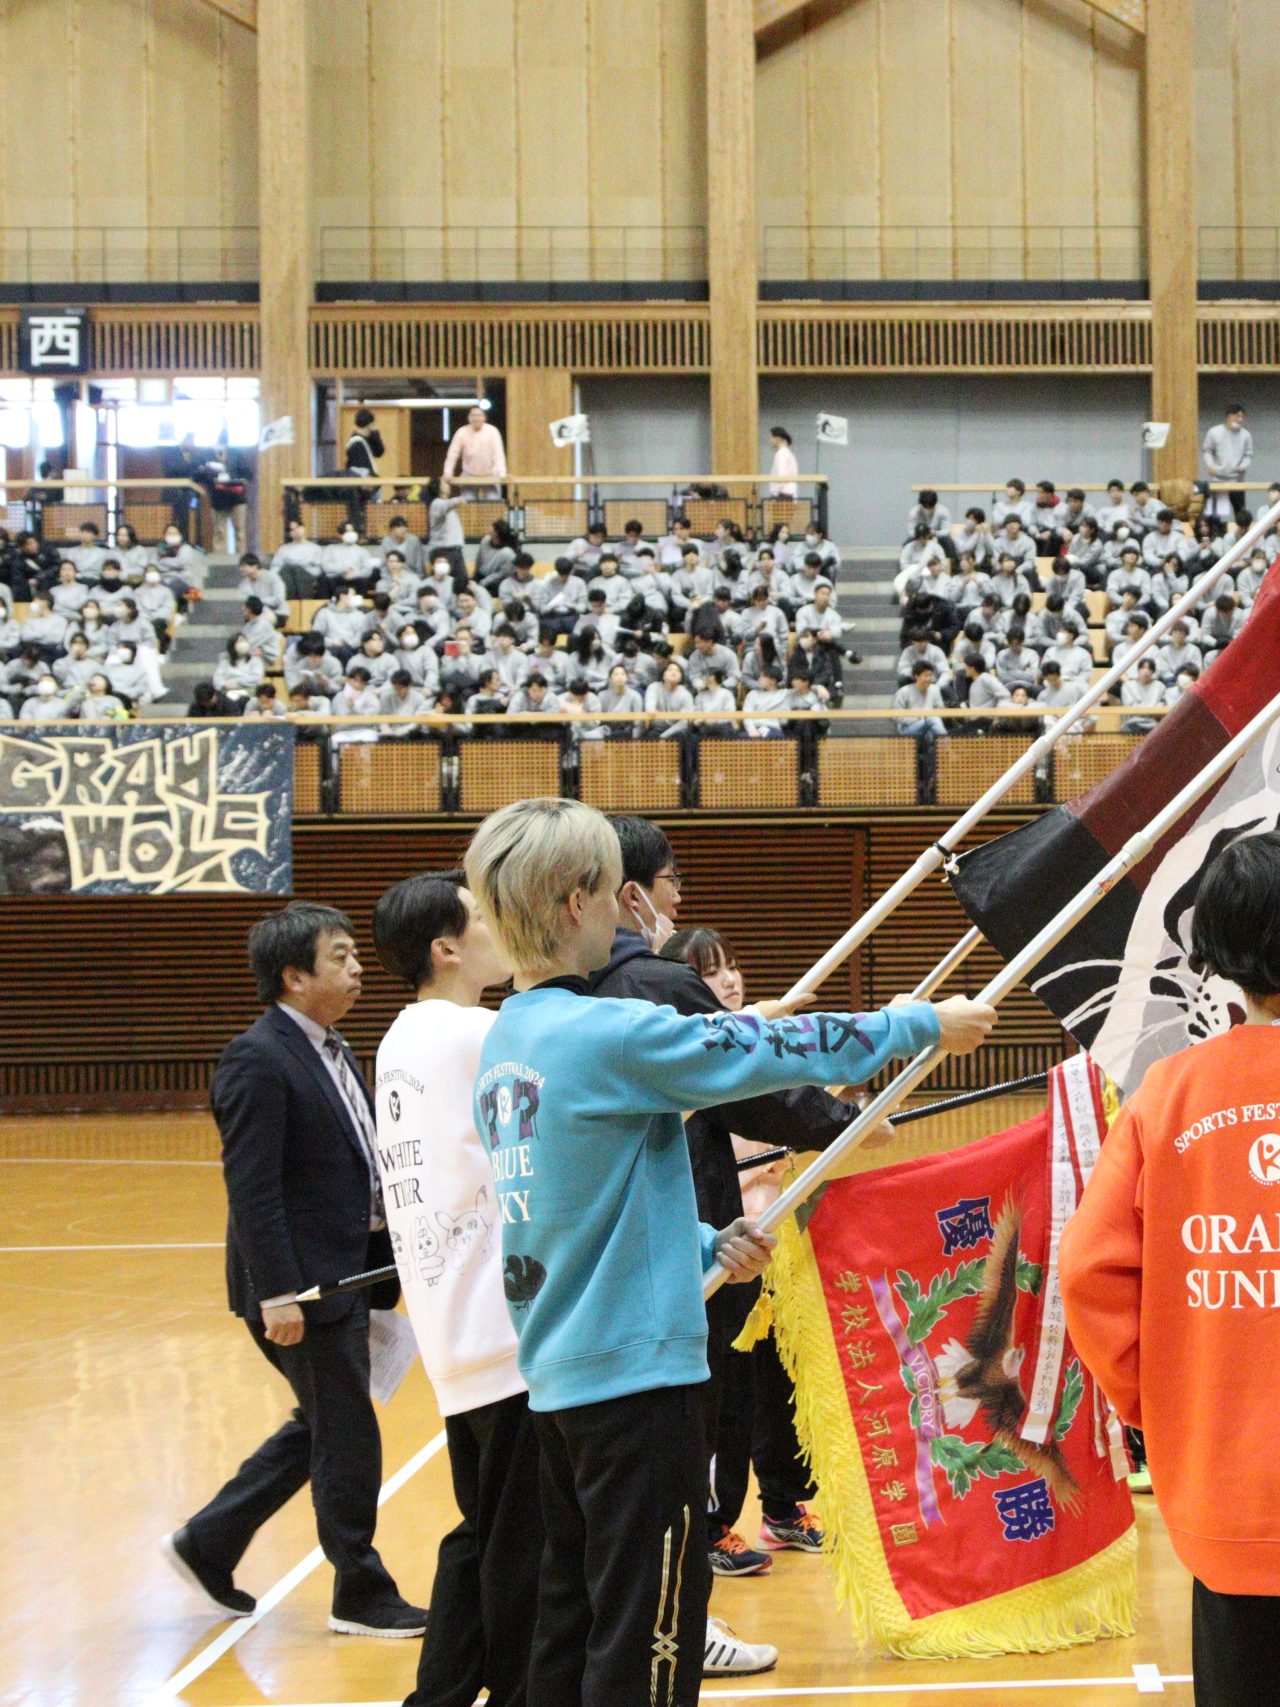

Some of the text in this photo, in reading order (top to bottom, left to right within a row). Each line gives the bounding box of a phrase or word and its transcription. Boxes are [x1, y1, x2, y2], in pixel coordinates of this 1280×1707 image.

[28, 315, 81, 367] 西
[1174, 1107, 1238, 1153] SPORTS
[379, 1140, 423, 1173] WHITE
[491, 1144, 534, 1182] BLUE
[498, 1189, 531, 1224] KY
[834, 1270, 920, 1549] 学校法人河原学園
[910, 1354, 935, 1429] VICTORY
